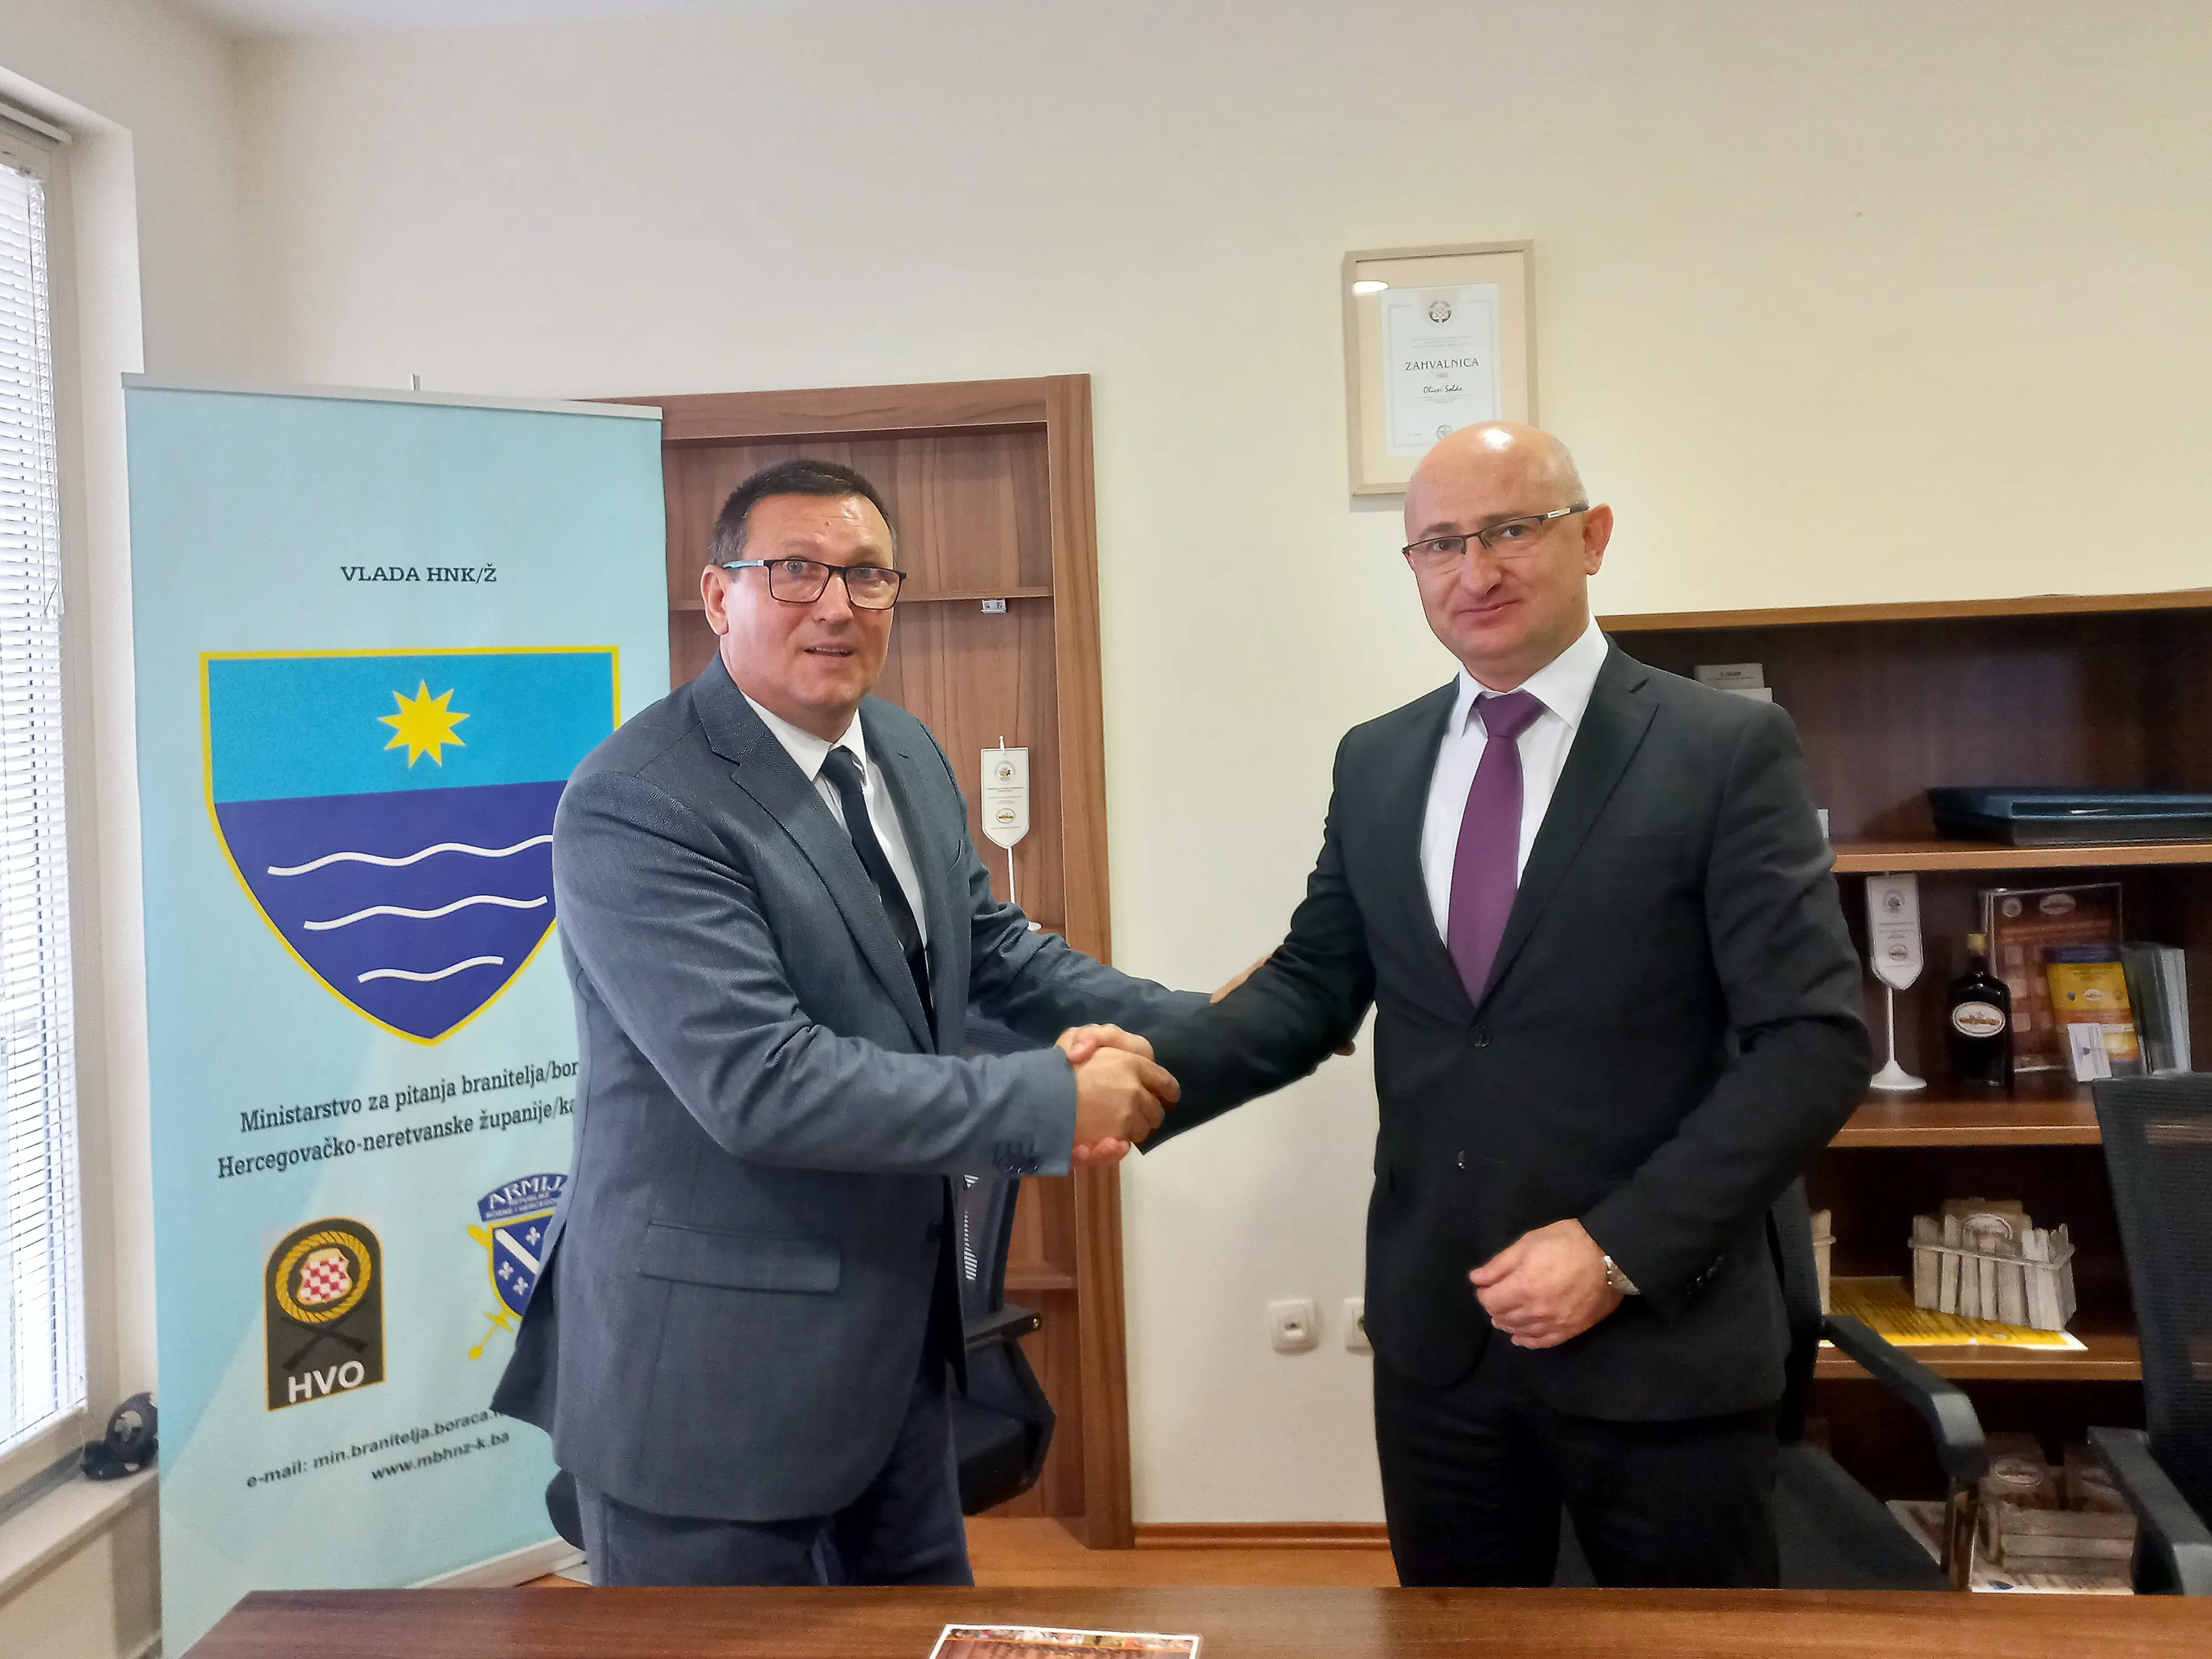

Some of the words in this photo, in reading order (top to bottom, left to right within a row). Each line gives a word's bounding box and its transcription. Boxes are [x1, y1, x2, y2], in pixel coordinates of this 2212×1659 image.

[1405, 358, 1479, 371] ZAHVALNICA
[340, 566, 421, 582] VLADA
[427, 562, 497, 584] HNK/Ž
[240, 1098, 362, 1133] Ministarstvo
[368, 1094, 389, 1111] za
[395, 1078, 457, 1112] pitanja
[217, 1115, 474, 1179] Hercegovačko-neretvanske
[289, 1360, 365, 1404] HVO
[247, 1460, 307, 1488] e-mail:
[372, 1432, 510, 1480] www.mbhnz-k.ba
